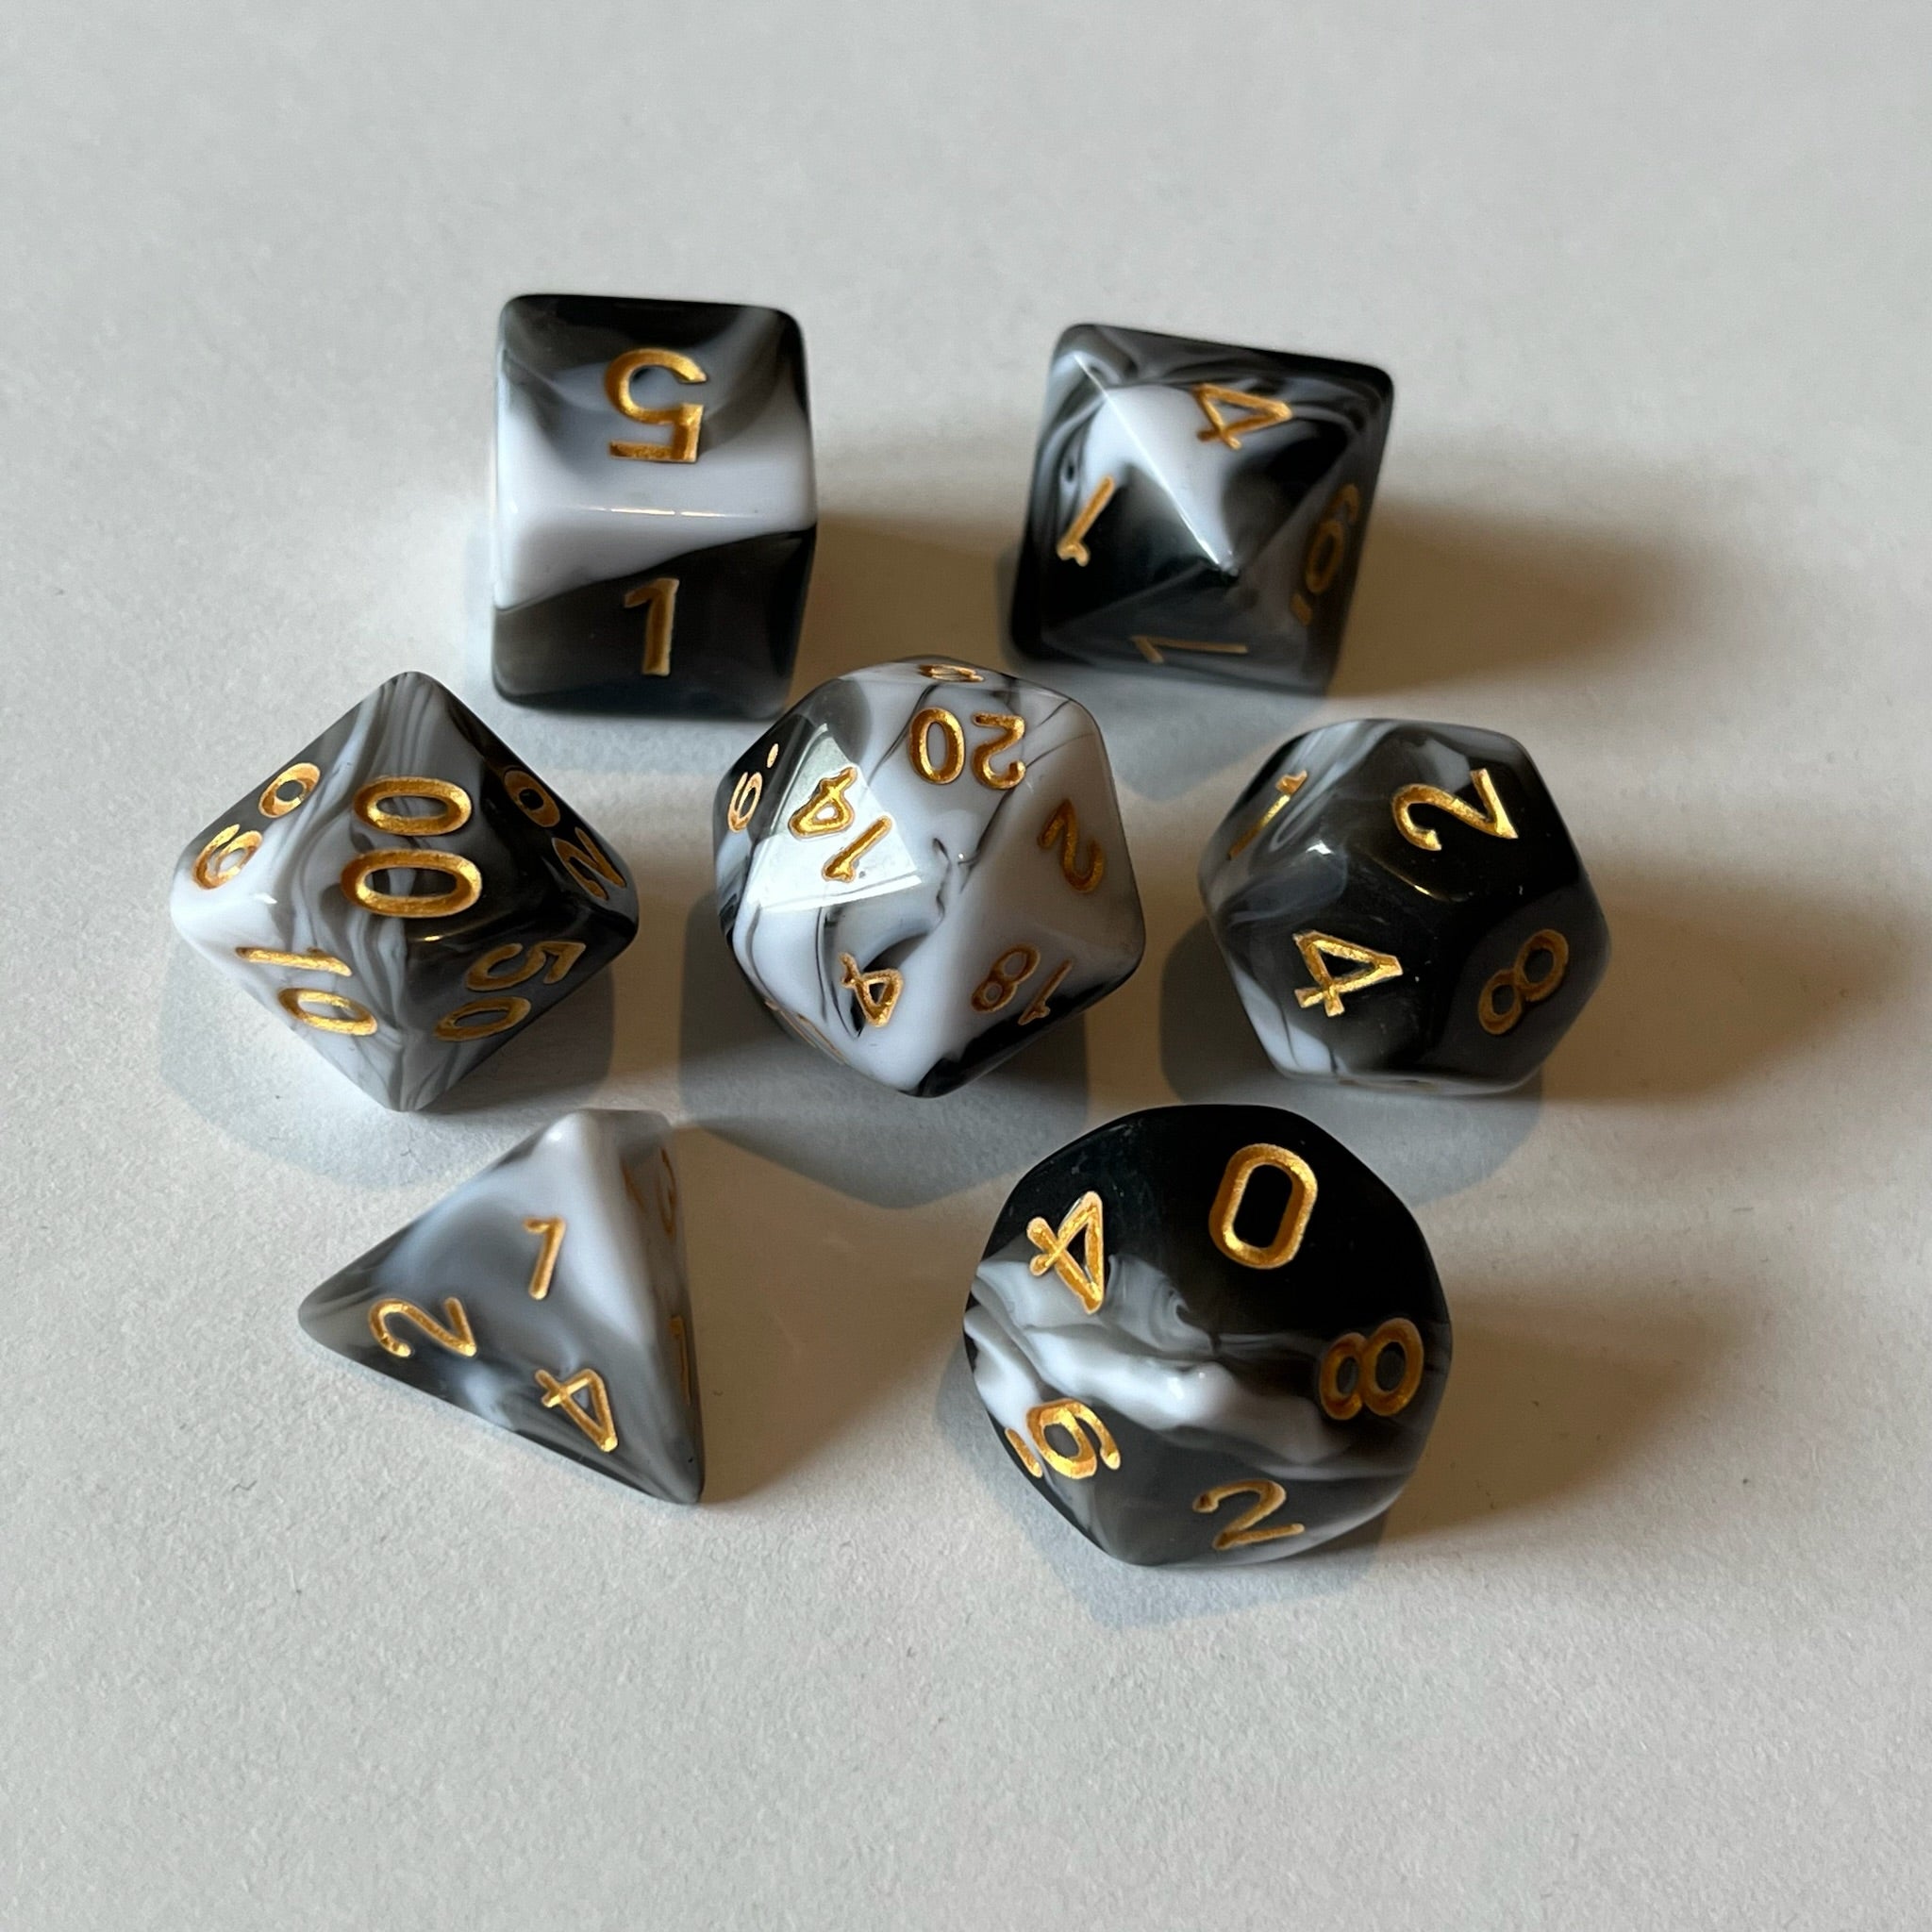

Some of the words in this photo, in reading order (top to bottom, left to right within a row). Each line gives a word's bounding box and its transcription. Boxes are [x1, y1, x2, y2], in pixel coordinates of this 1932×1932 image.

[605, 347, 707, 463] 5
[1192, 383, 1292, 450] 4
[624, 578, 679, 676] 1
[908, 708, 1026, 791] 20
[341, 777, 481, 918] 00
[788, 766, 891, 882] 14
[1039, 799, 1105, 893] 2
[1227, 770, 1307, 860] 1
[1391, 768, 1518, 851] 2
[839, 952, 903, 1027] 4
[972, 946, 1073, 1025] 18
[1292, 929, 1404, 1017] 4
[1478, 928, 1570, 1035] 8
[1208, 1143, 1319, 1269] 0
[524, 1216, 566, 1300] 1
[1026, 1191, 1104, 1313] 4
[369, 1297, 477, 1357] 2
[1322, 1318, 1424, 1420] 8
[535, 1369, 619, 1453] 4
[1192, 1479, 1305, 1550] 2
